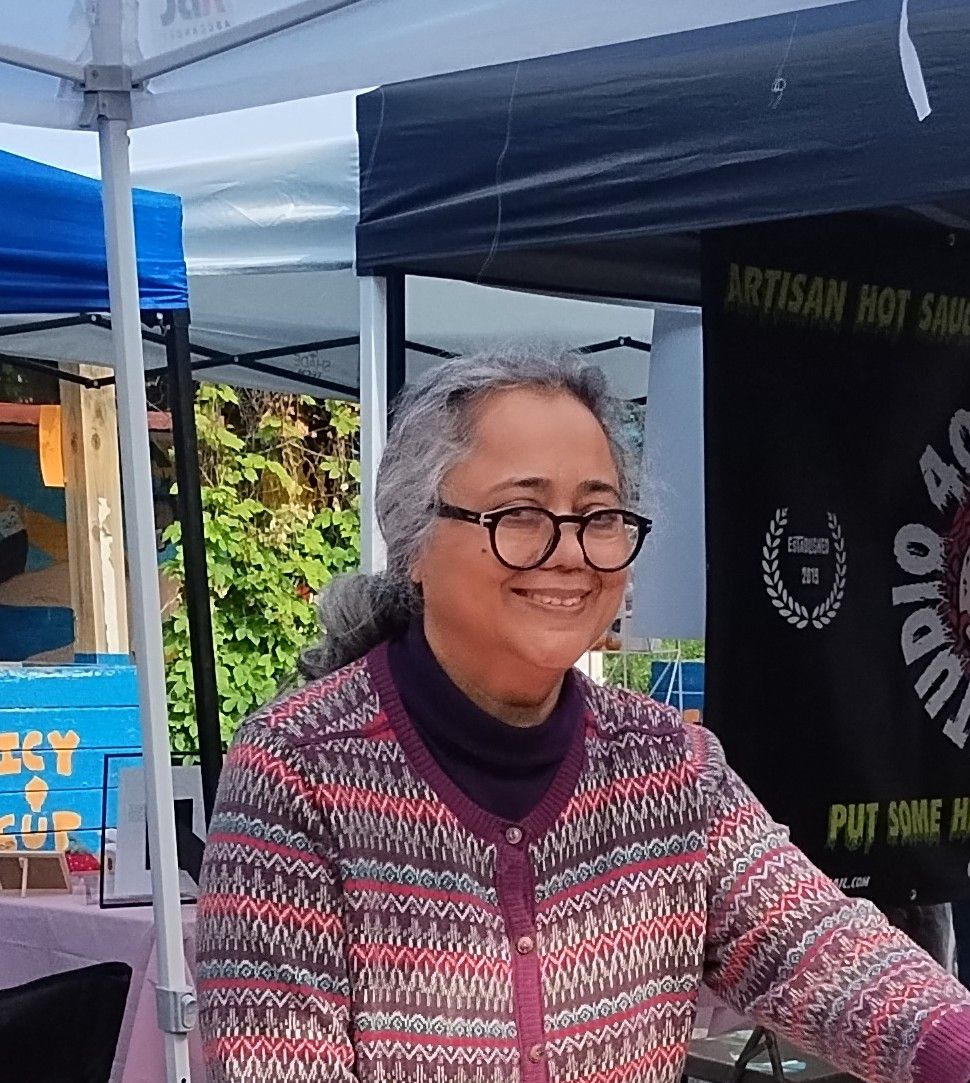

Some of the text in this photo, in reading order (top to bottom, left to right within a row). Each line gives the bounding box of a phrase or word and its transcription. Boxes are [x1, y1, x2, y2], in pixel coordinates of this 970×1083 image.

[727, 263, 848, 325] ARTISAN
[857, 284, 911, 333] HOT
[828, 801, 879, 847] PUT
[888, 798, 943, 842] SOME
